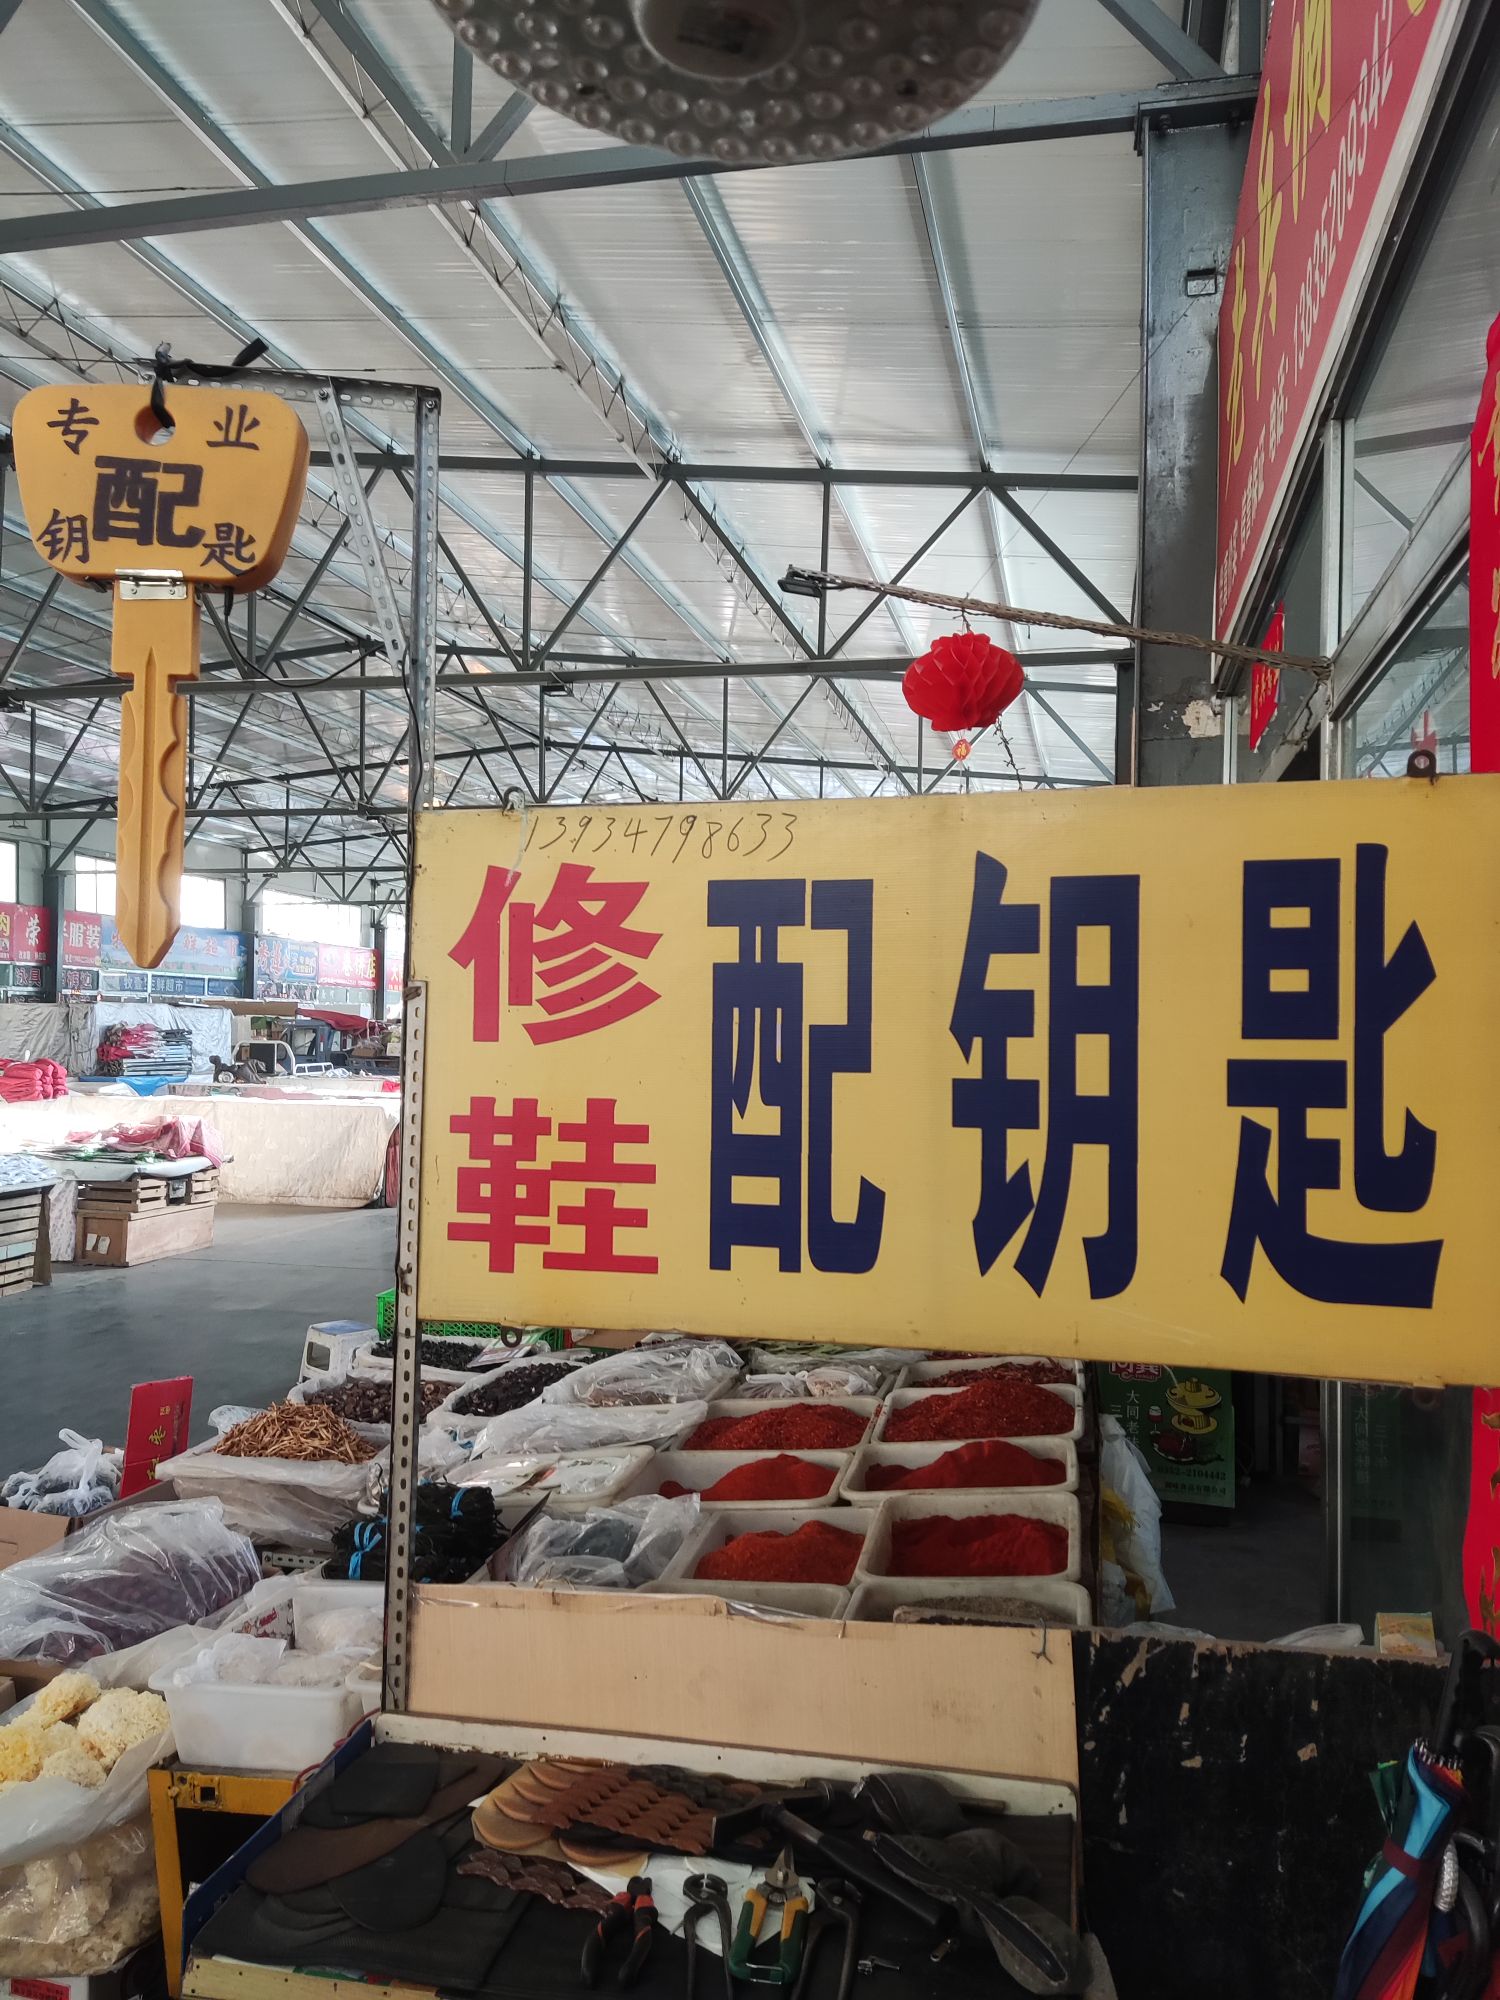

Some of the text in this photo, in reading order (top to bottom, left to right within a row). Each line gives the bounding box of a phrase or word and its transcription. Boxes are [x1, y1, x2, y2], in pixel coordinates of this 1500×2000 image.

[47, 398, 261, 455] 专业
[37, 508, 256, 577] 钥匙
[93, 455, 205, 549] 配
[525, 813, 798, 863] 13934798633
[447, 862, 664, 1274] 修鞋
[707, 843, 1445, 1309] 配钥匙
